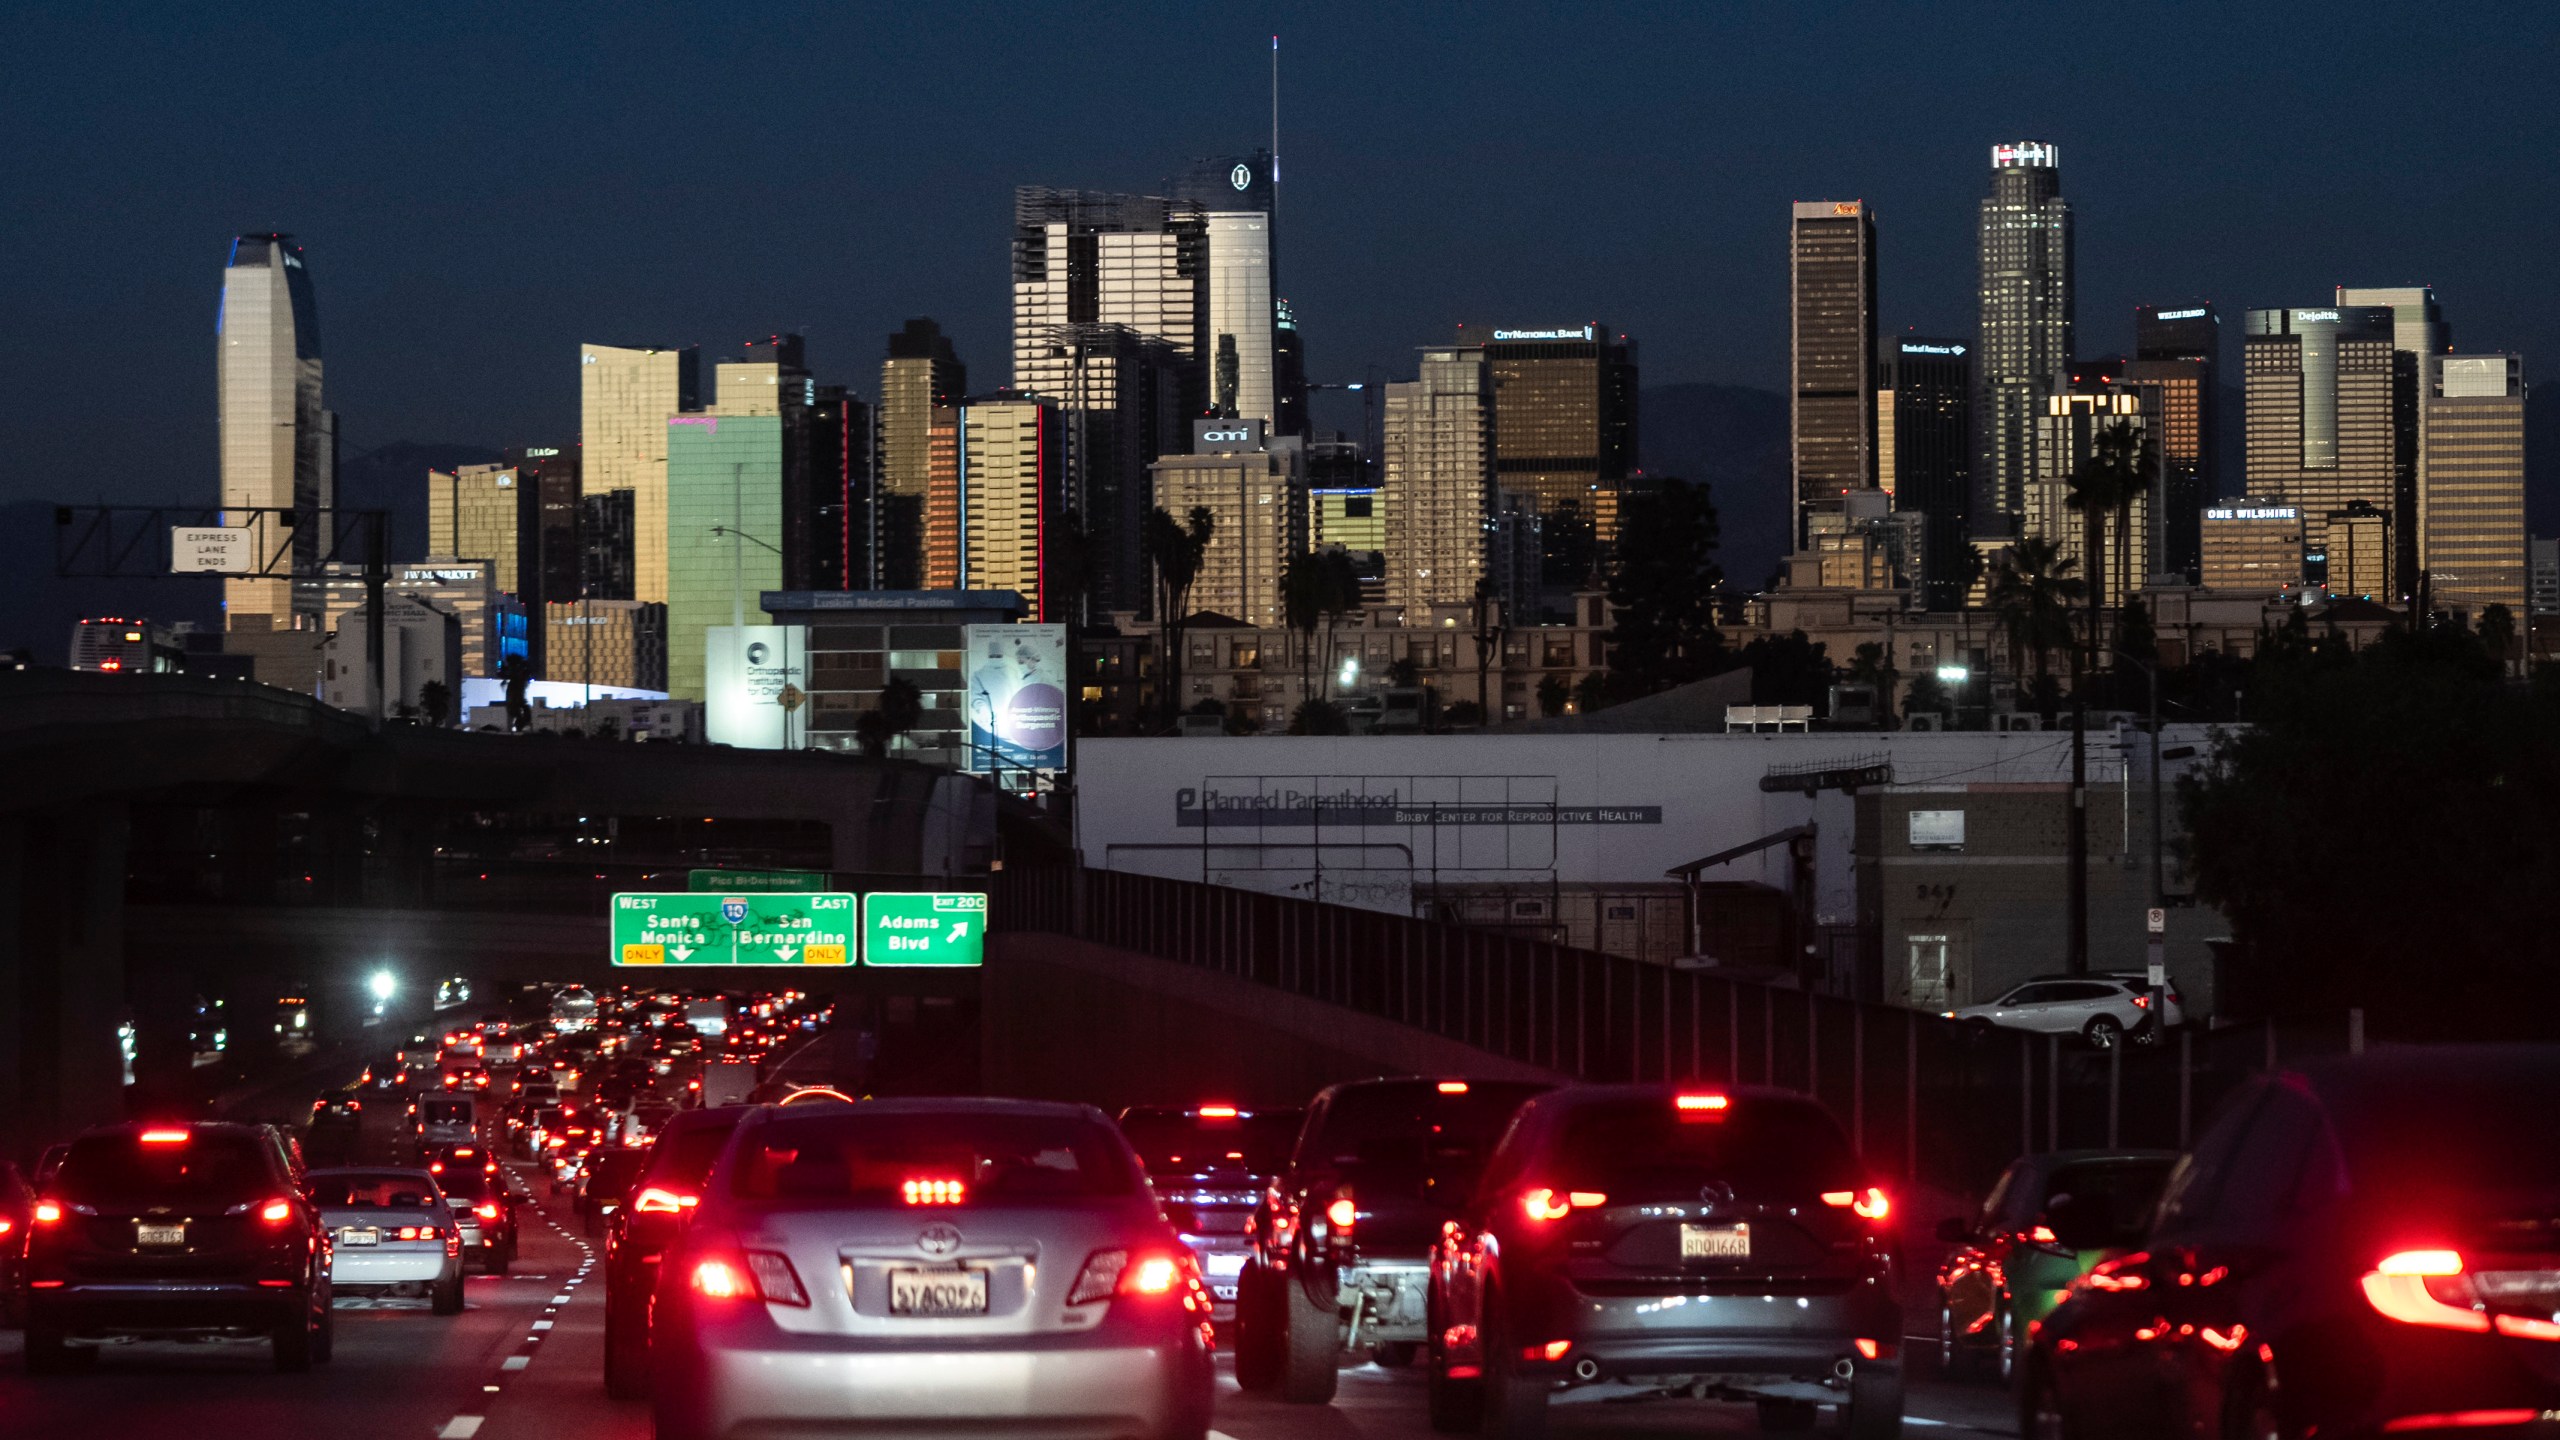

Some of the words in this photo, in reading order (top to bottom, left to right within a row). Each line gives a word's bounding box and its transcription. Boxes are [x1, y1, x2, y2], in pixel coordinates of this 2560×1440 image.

[1513, 330, 1557, 339] NATIONAL
[1558, 329, 1583, 338] BANK
[1902, 344, 1918, 352] Bank
[1925, 345, 1950, 353] America
[2207, 509, 2233, 519] ONE
[2236, 509, 2295, 518] WILSHIRE
[187, 534, 238, 542] EXPRESS
[198, 546, 227, 554] LANE
[198, 558, 227, 566] ENDS
[813, 598, 854, 608] Luskin
[857, 598, 903, 608] Medical
[907, 597, 955, 608] Pavilion
[1203, 789, 1279, 811] Planned
[1286, 788, 1398, 810] Parenthood
[1435, 811, 1476, 823] CENTER
[1599, 810, 1643, 821] HEALTH
[619, 897, 658, 909] WEST
[811, 897, 850, 909] EAST
[957, 897, 985, 908] 20C
[727, 905, 744, 918] 10
[647, 914, 700, 929] Santa
[779, 914, 812, 929] San
[879, 915, 940, 929] Adams
[641, 931, 705, 944] Monica
[739, 930, 846, 944] Bernardino
[888, 936, 930, 950] Blvd
[625, 949, 662, 960] ONLY
[807, 948, 842, 959] ONLY
